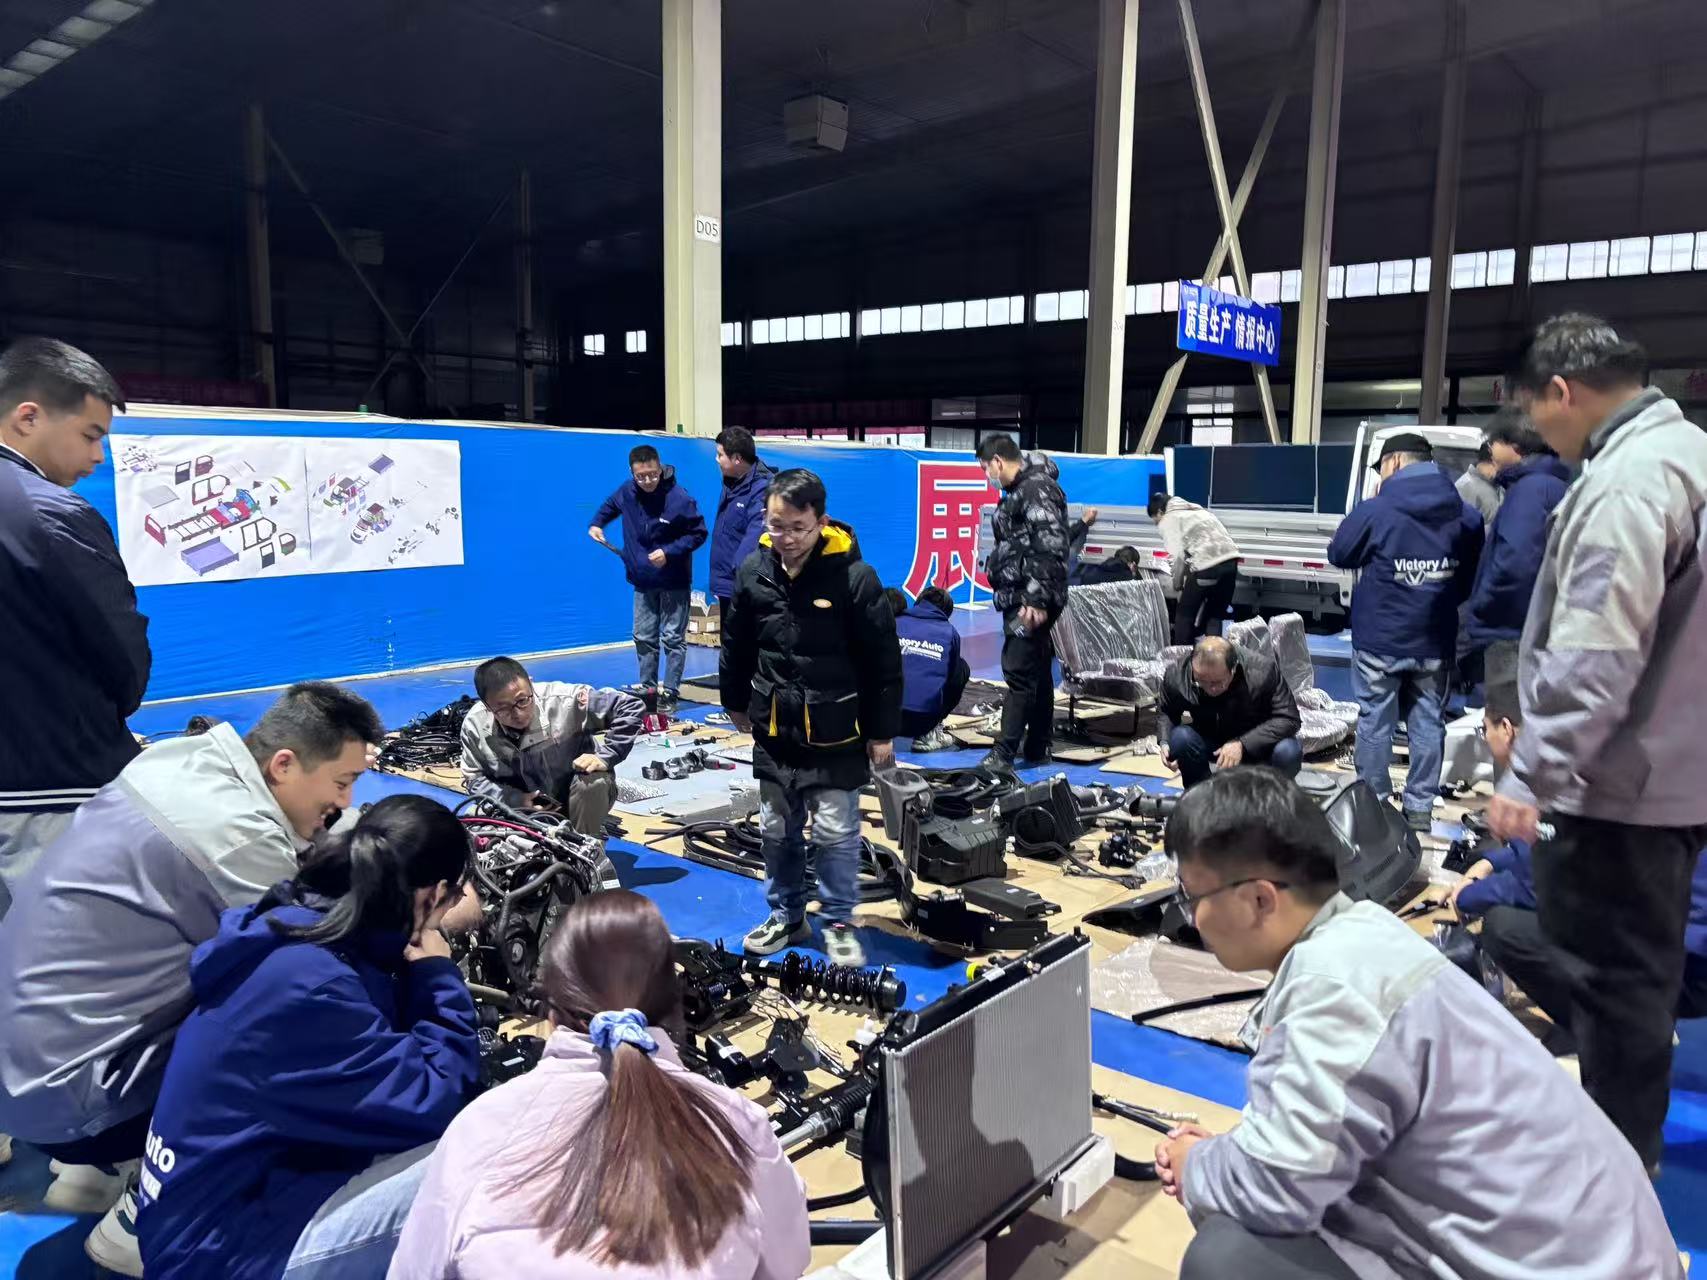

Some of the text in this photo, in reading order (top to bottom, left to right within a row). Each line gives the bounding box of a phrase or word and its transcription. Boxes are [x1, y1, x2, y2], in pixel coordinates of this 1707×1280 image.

[696, 219, 719, 237] D05
[1185, 300, 1276, 355] 质量生产 情报中心
[1394, 558, 1440, 572] Victory
[921, 640, 944, 653] Auto
[145, 1116, 176, 1174] uto
